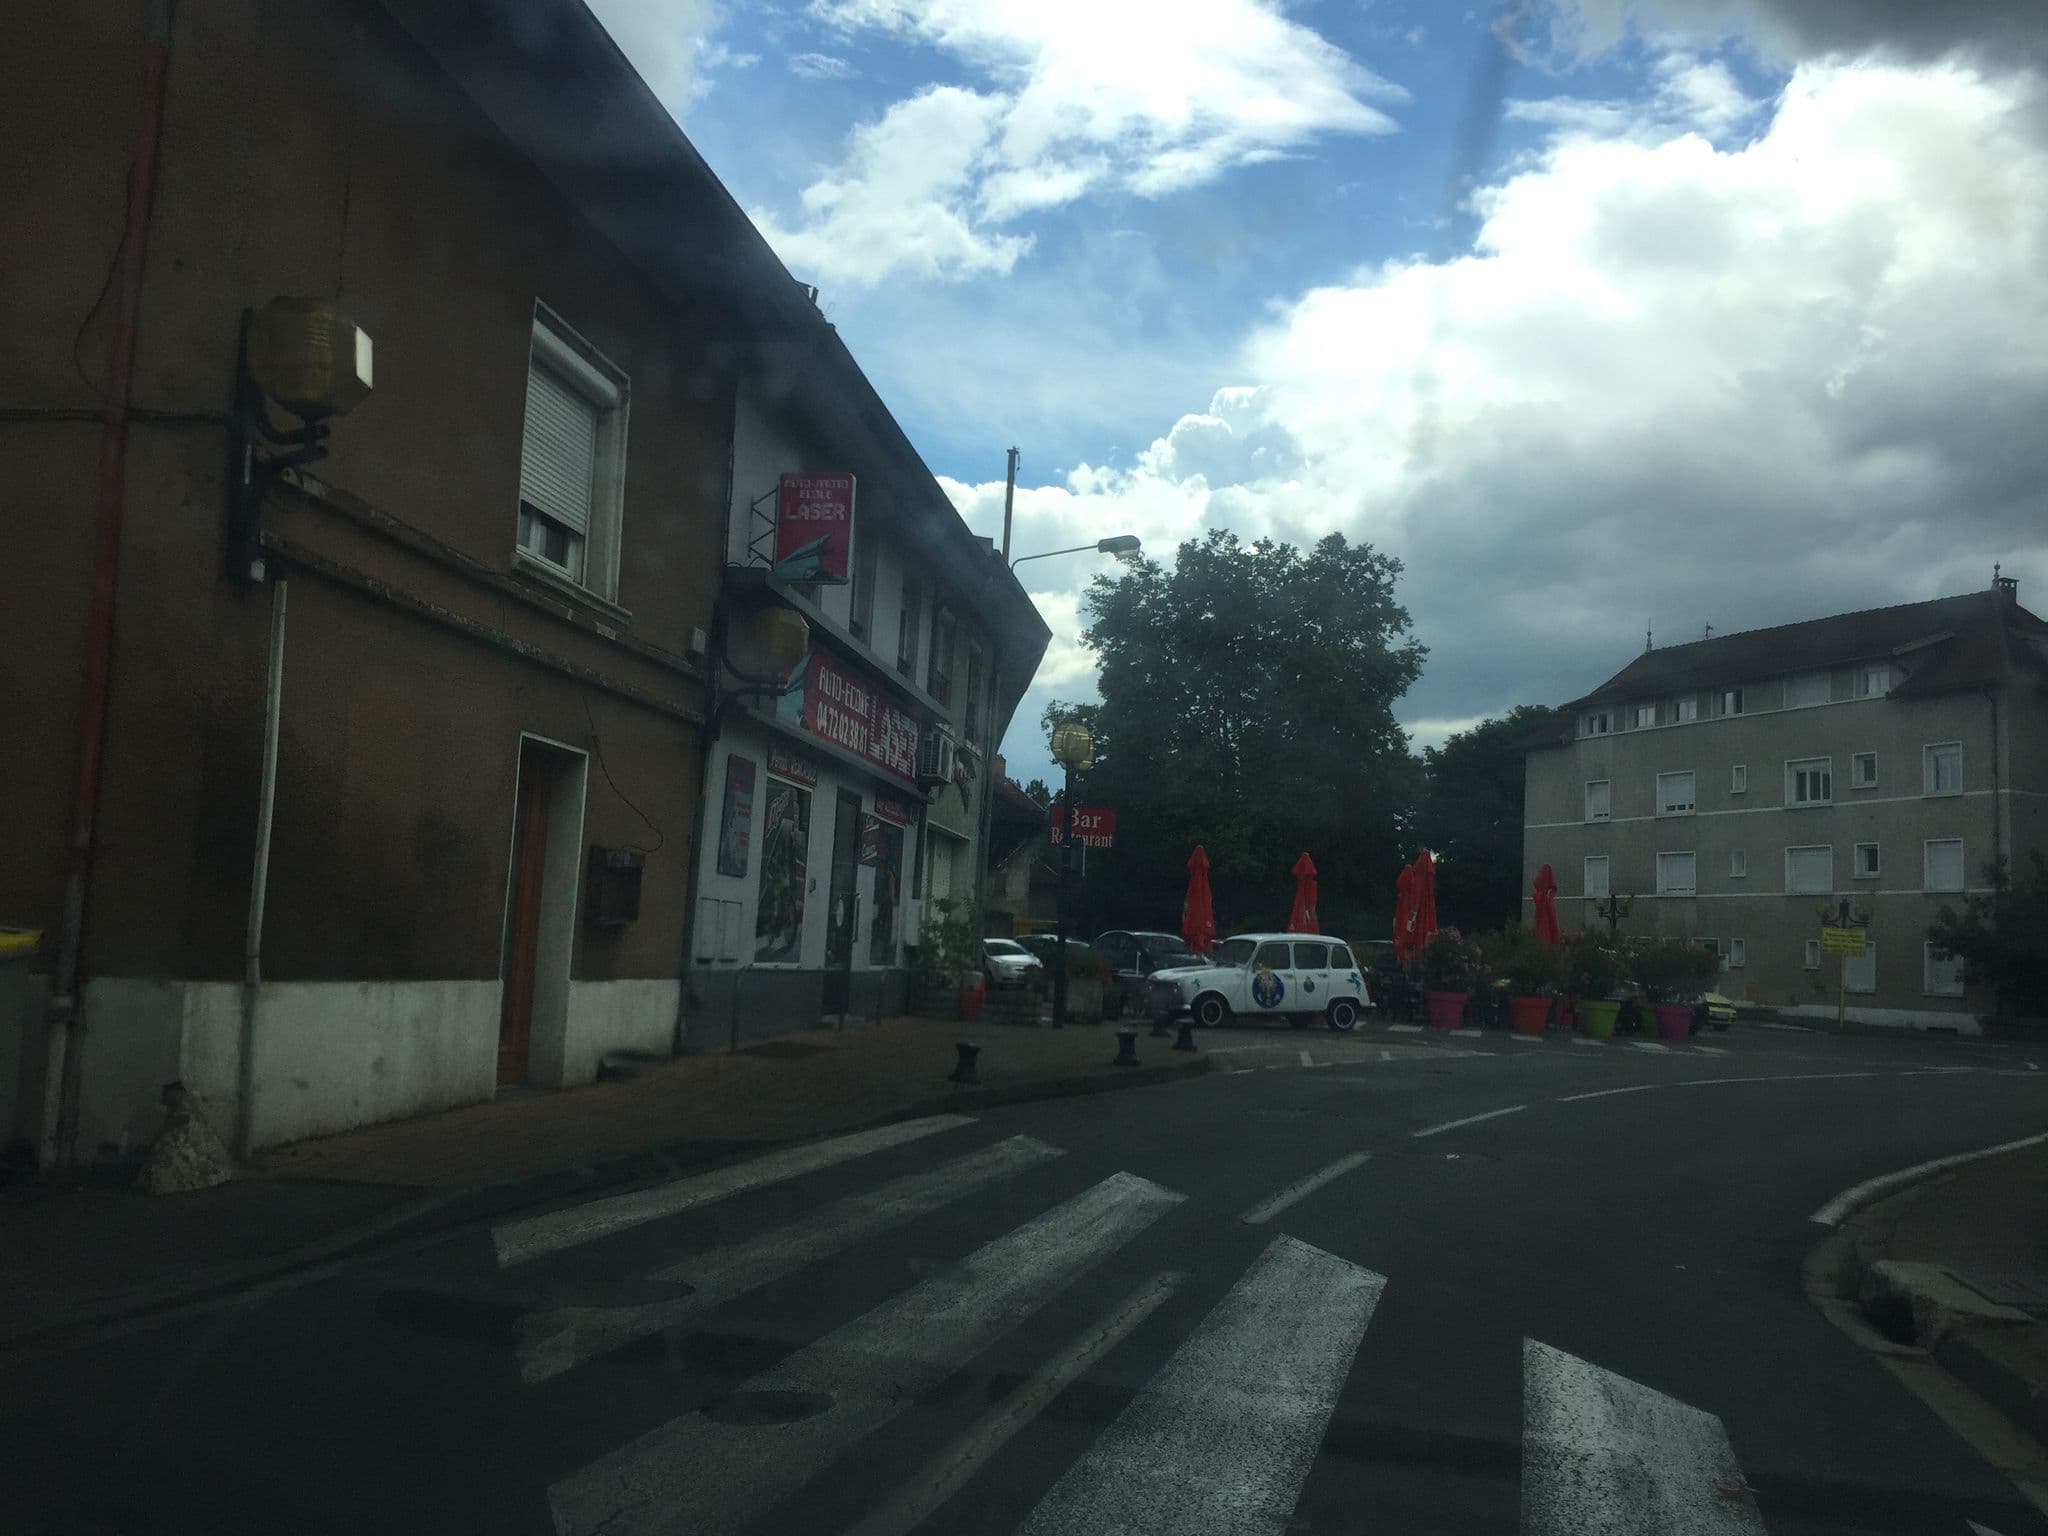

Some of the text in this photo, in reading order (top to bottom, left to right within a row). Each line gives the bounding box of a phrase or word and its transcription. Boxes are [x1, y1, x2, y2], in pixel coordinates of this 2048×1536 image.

[784, 501, 846, 521] LASER
[868, 695, 919, 779] LASER
[1071, 807, 1102, 828] Bar
